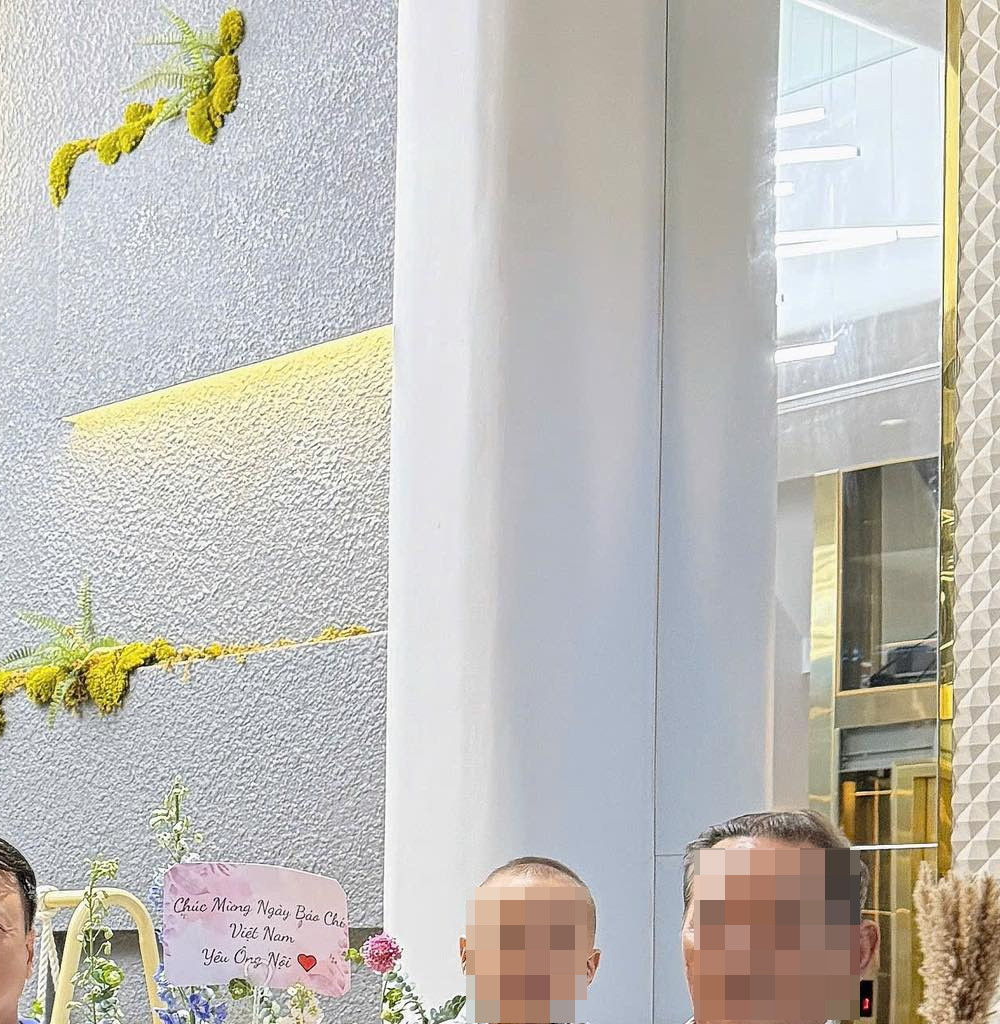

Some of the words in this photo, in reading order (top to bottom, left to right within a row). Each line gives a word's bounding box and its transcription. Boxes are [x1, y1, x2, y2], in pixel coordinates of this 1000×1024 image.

[173, 896, 208, 914] Chúc
[257, 899, 290, 922] Ngày
[295, 904, 320, 922] Báo
[229, 922, 259, 942] Việt
[263, 925, 295, 944] Nam
[201, 947, 230, 967] Yêu
[233, 945, 263, 969] Ông
[268, 951, 292, 970] Nội
